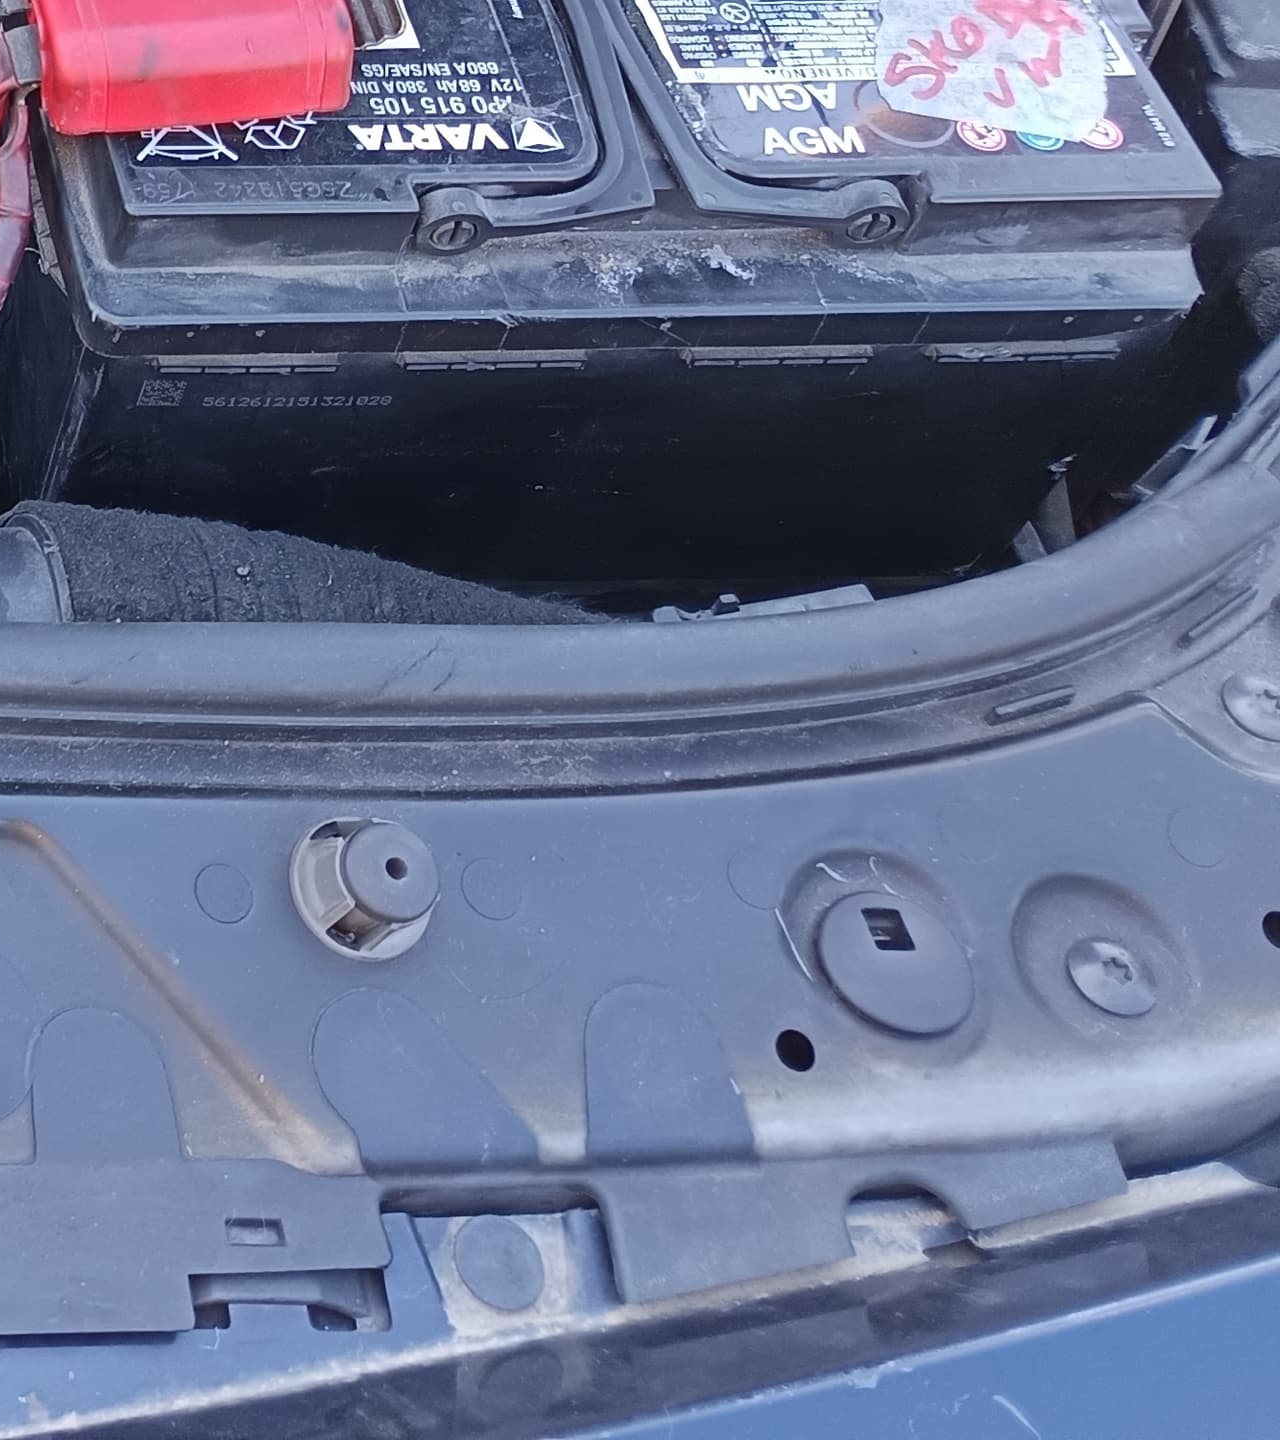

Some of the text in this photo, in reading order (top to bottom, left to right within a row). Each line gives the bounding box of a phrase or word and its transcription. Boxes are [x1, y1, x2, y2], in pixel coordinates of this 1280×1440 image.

[360, 60, 500, 78] 680A EN/SAE/GS
[349, 78, 524, 95] 12V 68Ah 380A DIN
[369, 95, 415, 115] 105
[420, 95, 467, 114] 915
[735, 83, 837, 113] AGM
[347, 122, 510, 151] VARTA
[763, 125, 866, 155] AGM
